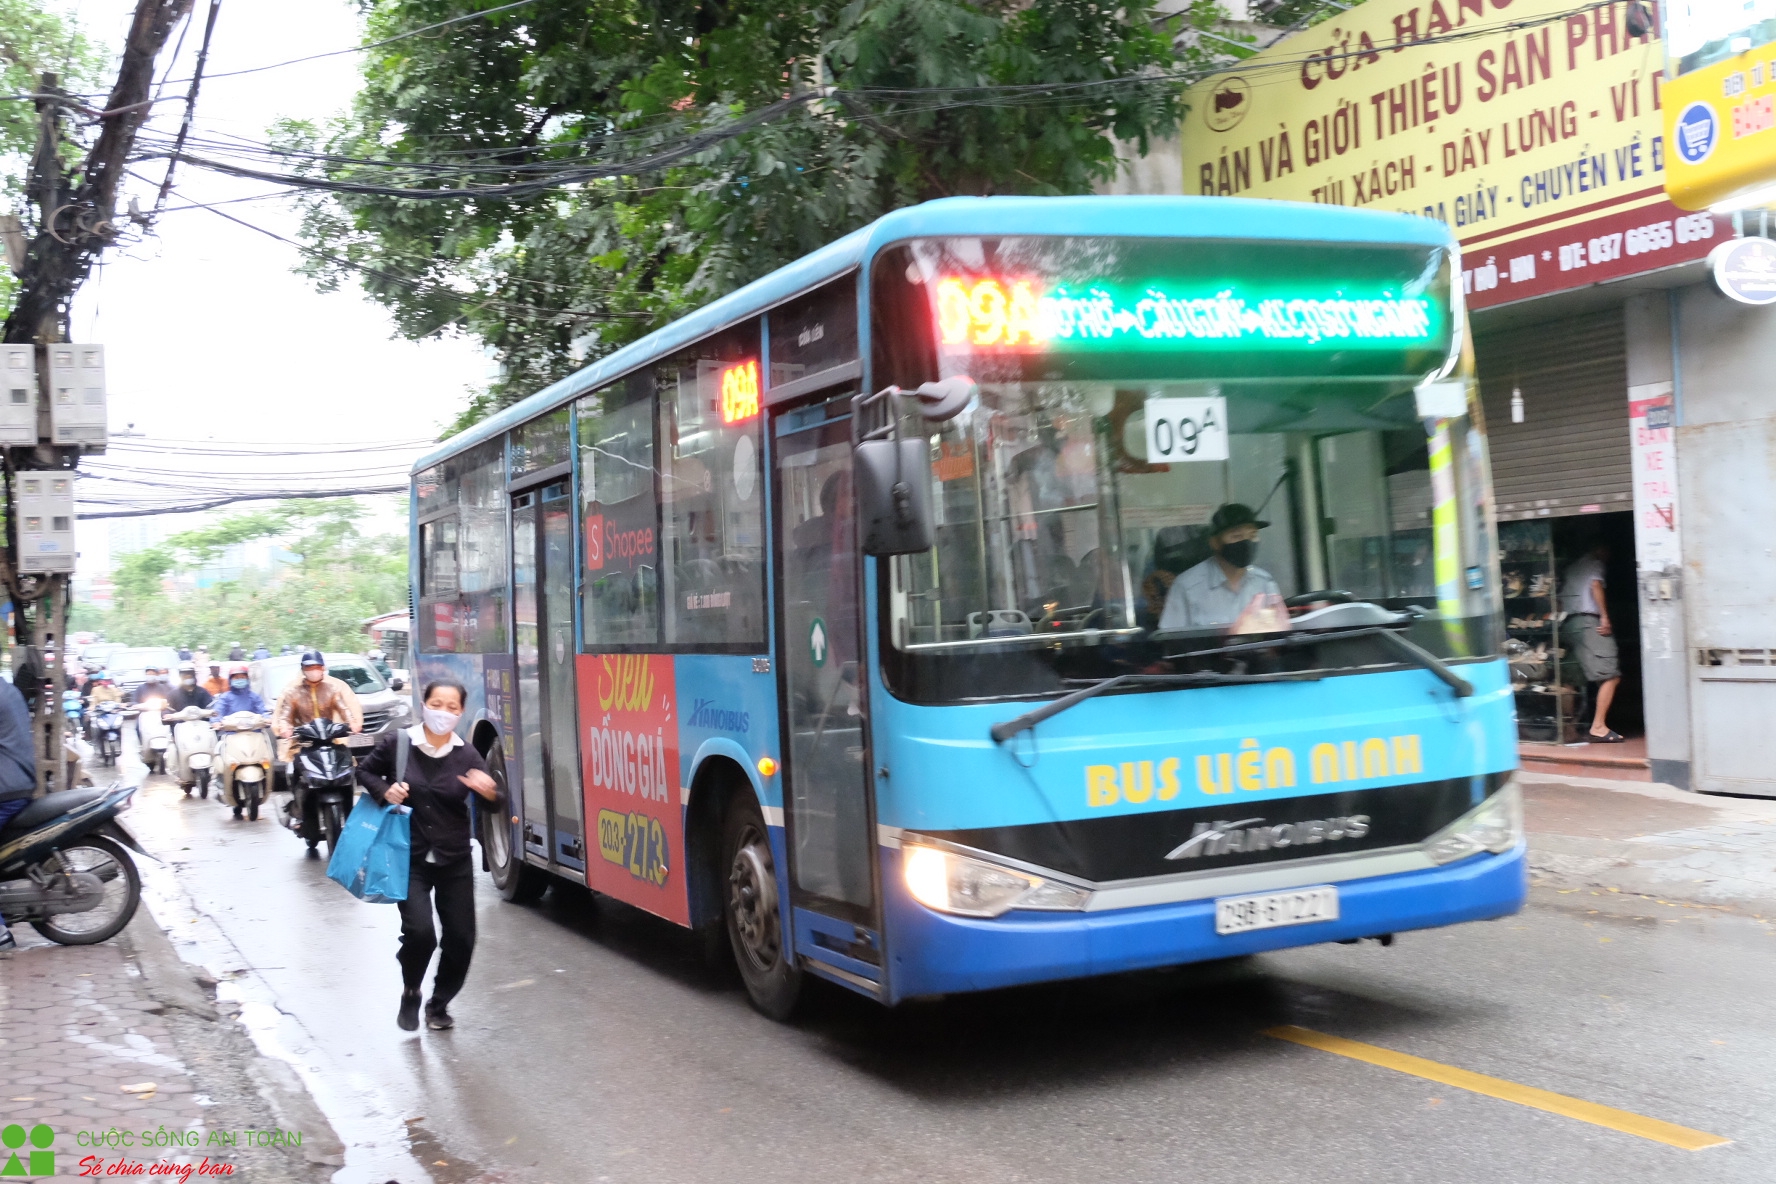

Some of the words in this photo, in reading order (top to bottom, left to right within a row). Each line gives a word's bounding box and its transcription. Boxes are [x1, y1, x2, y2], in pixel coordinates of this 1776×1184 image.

[1301, 28, 1380, 90] CỬA
[1199, 146, 1251, 196] BÁN
[1258, 122, 1295, 182] VÀ
[1303, 98, 1362, 167] GIỚI
[1371, 62, 1463, 141] THIỆU
[1352, 154, 1416, 207] XÁCH
[1442, 128, 1492, 178] DÂY
[1503, 100, 1578, 159] LƯNG
[1610, 69, 1639, 122] VÍ
[1456, 178, 1499, 228] GIÀY
[1614, 130, 1643, 181] VỀ
[937, 279, 1042, 346] 09A
[722, 360, 759, 424] 09A
[1154, 406, 1221, 456] 09A
[605, 519, 654, 569] Shopee
[590, 712, 637, 797] ĐỒNG
[636, 726, 669, 804] GIÁ
[1086, 757, 1181, 807] BUS
[1197, 738, 1296, 795] LIÊN
[1310, 734, 1424, 785] NINH
